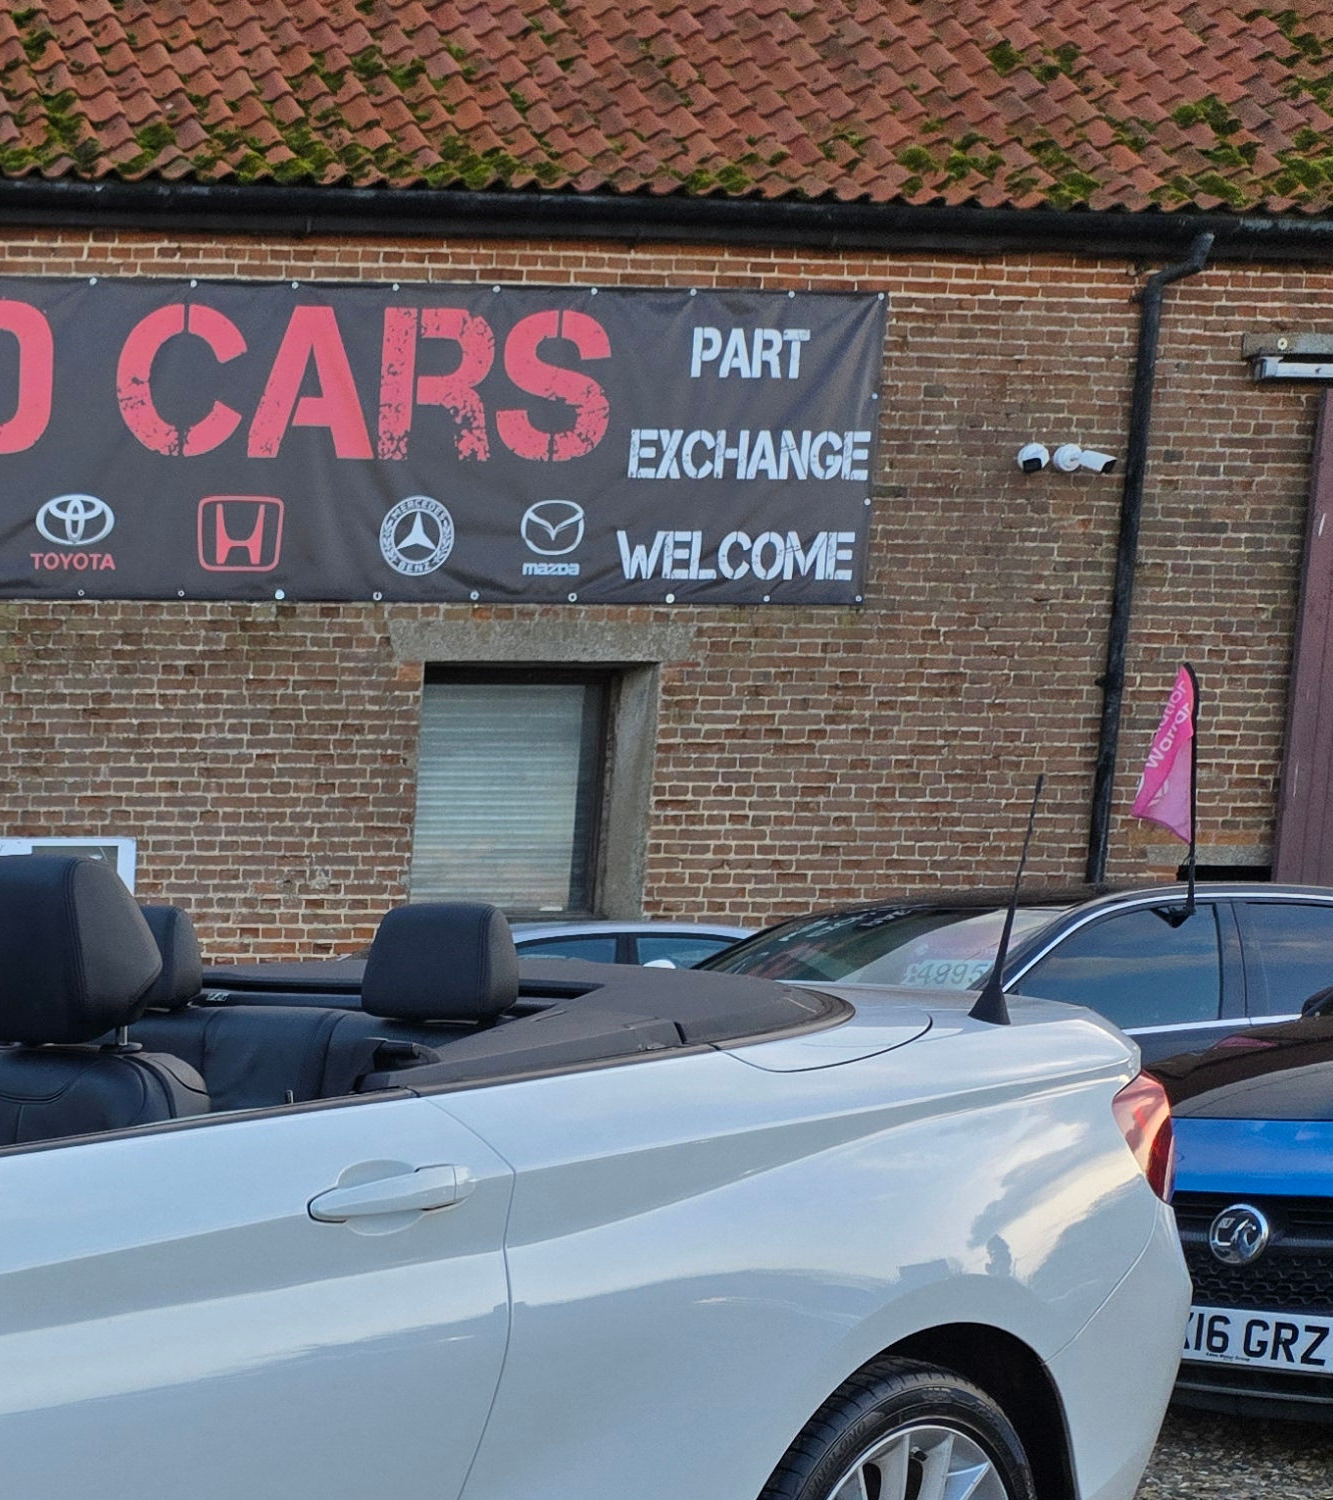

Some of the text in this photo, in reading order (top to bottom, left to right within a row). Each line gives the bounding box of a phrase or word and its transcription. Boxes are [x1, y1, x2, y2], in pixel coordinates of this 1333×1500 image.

[689, 326, 811, 379] PART
[116, 303, 612, 462] CARS
[627, 428, 871, 482] EXCHANGE
[30, 552, 116, 571] TOYOTA
[616, 530, 856, 581] WELCOME
[1243, 1319, 1330, 1366] GRZ
